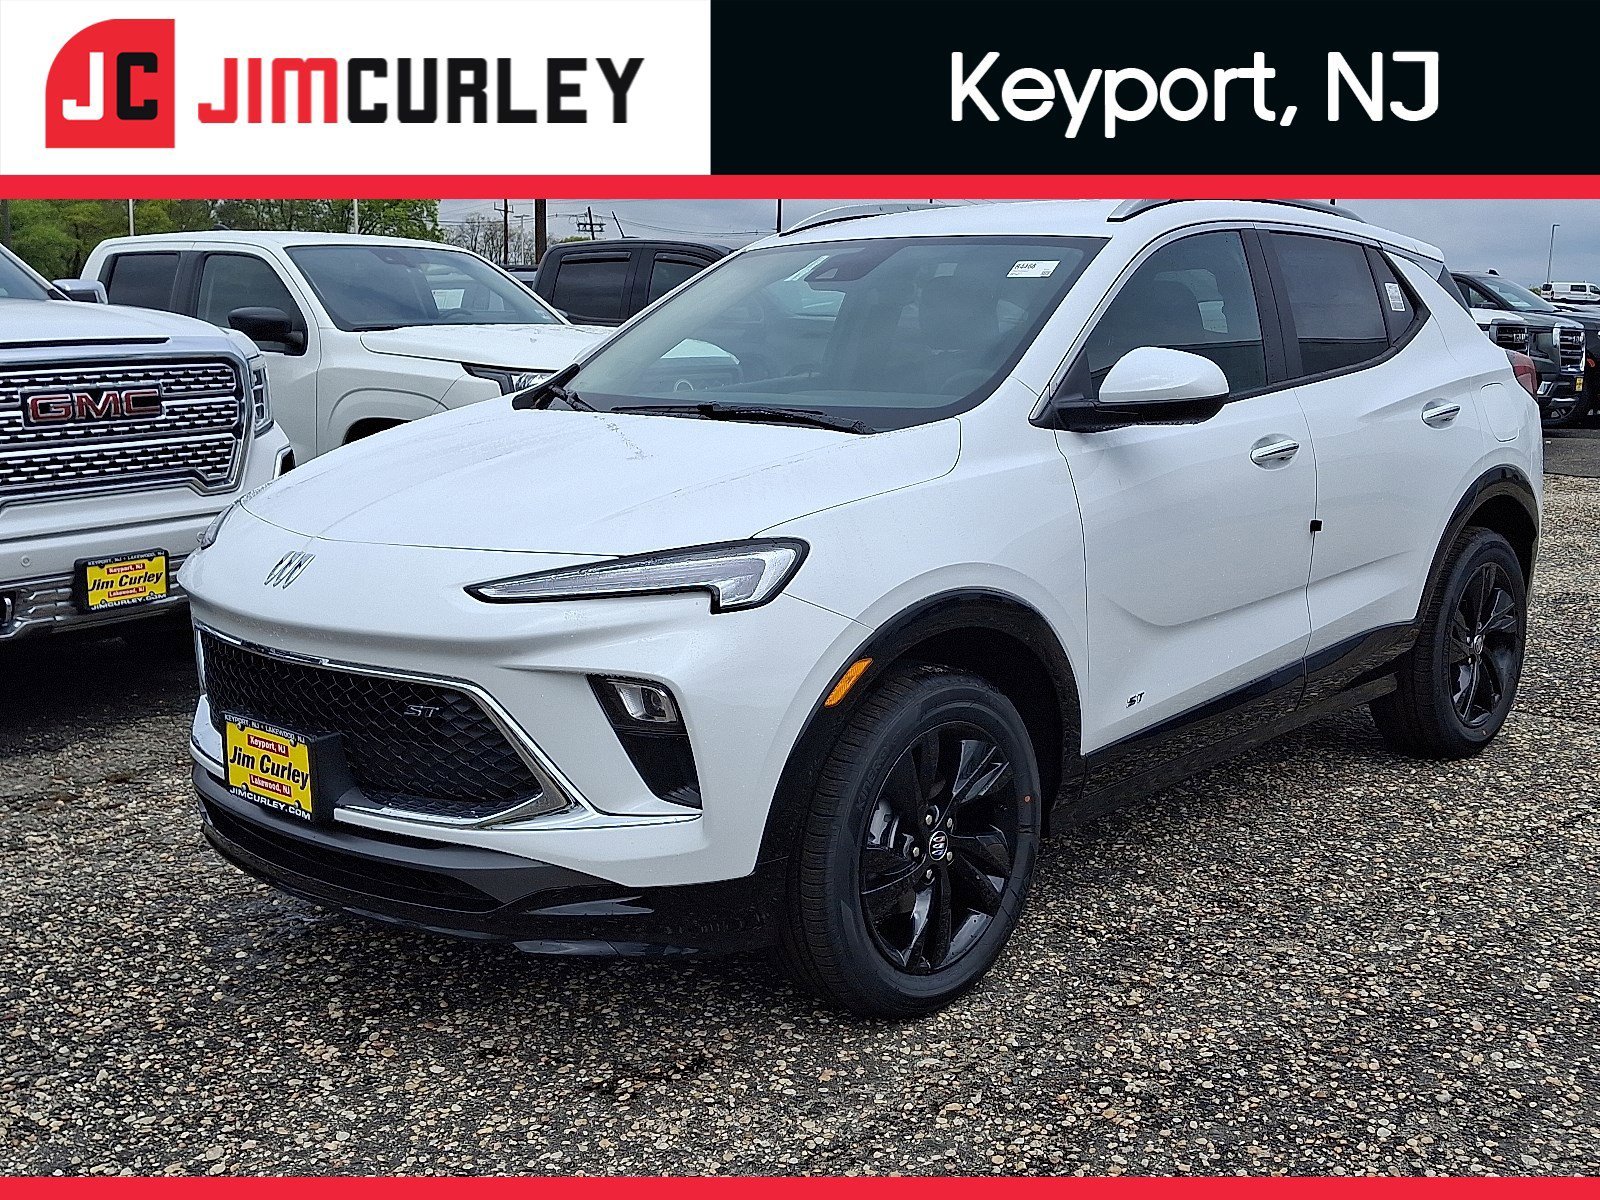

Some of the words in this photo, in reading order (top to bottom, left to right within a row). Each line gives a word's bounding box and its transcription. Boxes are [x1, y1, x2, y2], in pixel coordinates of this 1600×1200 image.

[27, 388, 161, 423] GMC
[88, 579, 114, 591] Jim
[119, 571, 163, 586] Curley
[1126, 691, 1145, 708] ST
[404, 704, 440, 717] ST
[250, 735, 277, 753] Keyport,
[277, 744, 286, 754] NJ
[230, 745, 256, 770] Jim
[259, 754, 309, 790] Curley
[250, 775, 282, 793] Lakewood,
[283, 785, 291, 795] NJ
[230, 787, 311, 820] JIMCURLEY.COM
